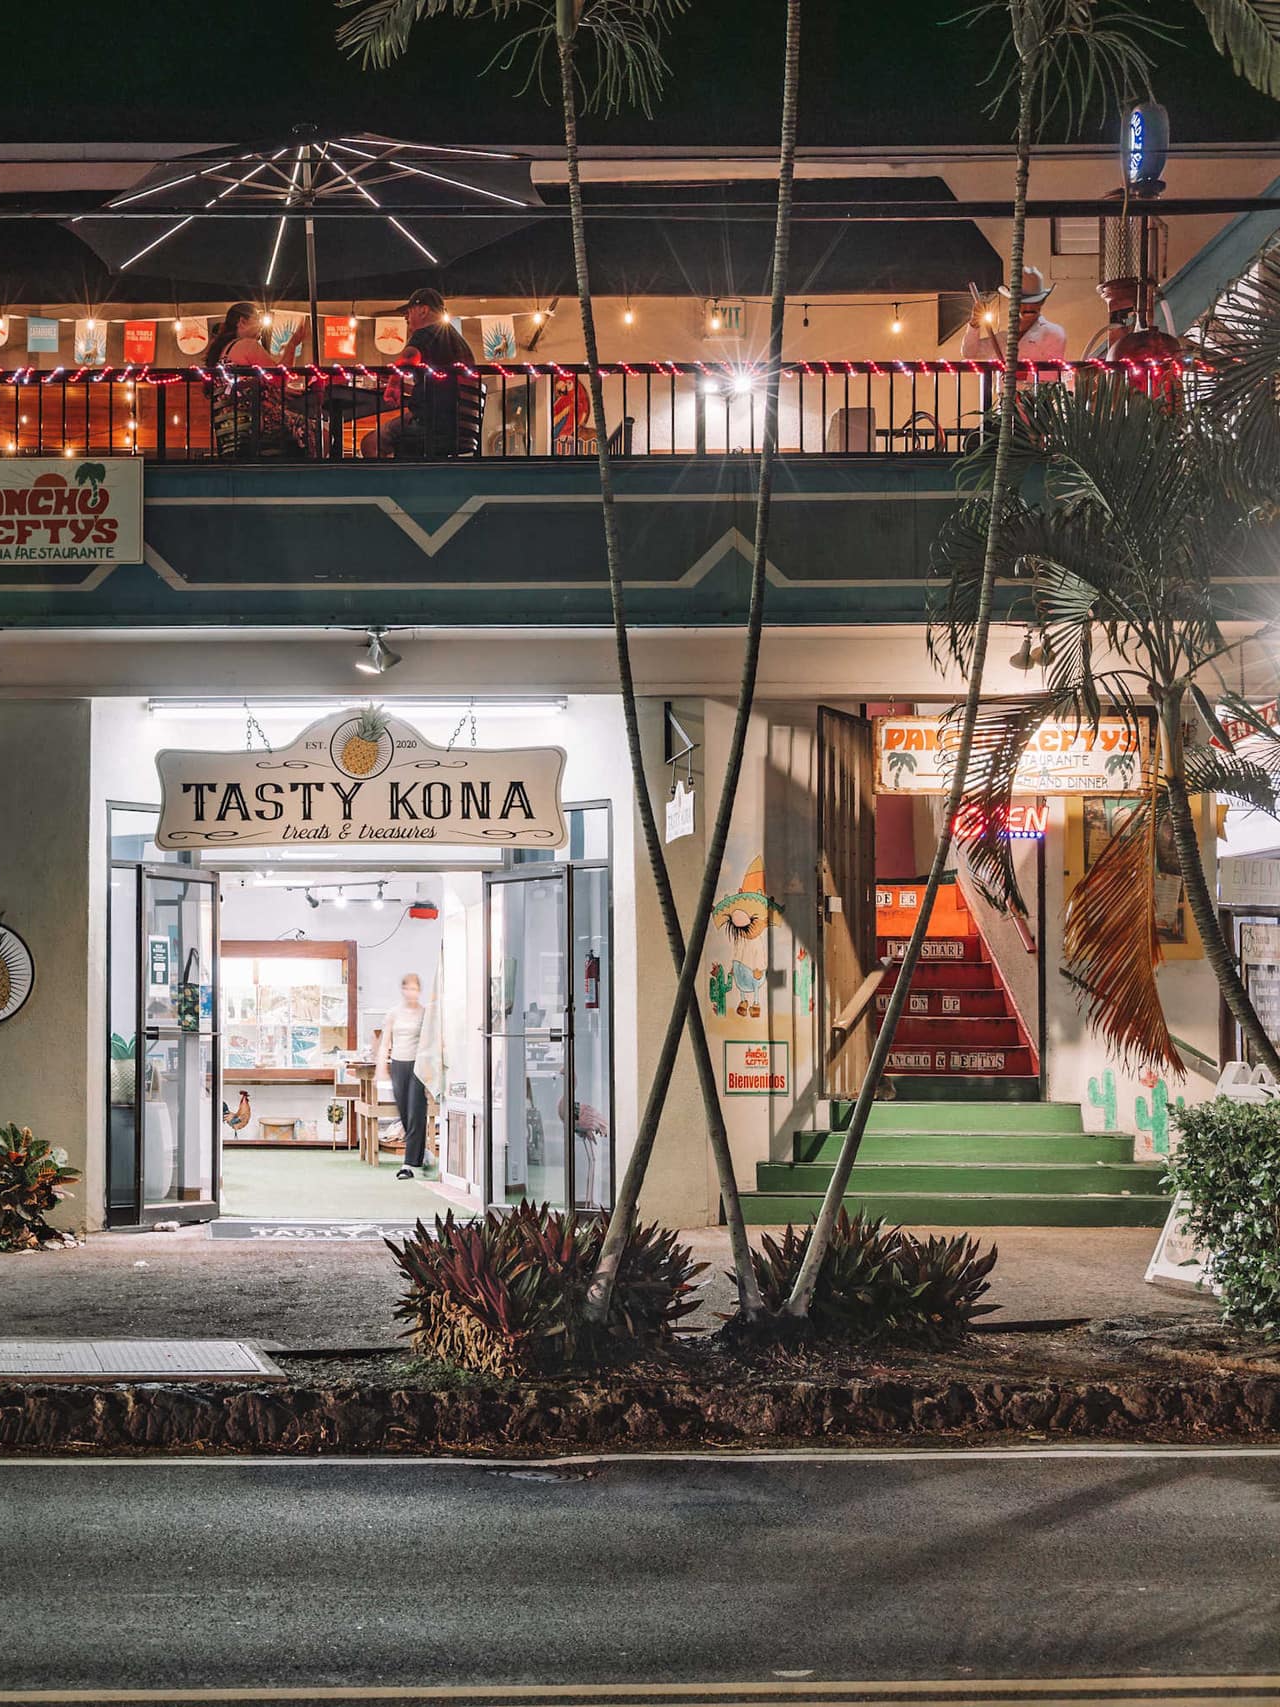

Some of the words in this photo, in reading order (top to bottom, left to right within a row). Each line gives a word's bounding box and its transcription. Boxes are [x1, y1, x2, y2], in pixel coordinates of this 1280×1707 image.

[21, 546, 115, 560] RESTAURANTE
[305, 741, 327, 751] EST.
[396, 740, 417, 749] 2020
[1039, 777, 1063, 788] AND
[1068, 777, 1108, 788] DINNER
[182, 781, 365, 822] TASTY
[389, 781, 536, 820] KONA
[951, 804, 1049, 838] OEN
[282, 823, 330, 840] treats
[338, 823, 351, 839] &
[358, 822, 438, 840] treasures
[922, 944, 963, 956] SHARE
[911, 998, 928, 1010] ON
[943, 1000, 960, 1010] UP
[886, 1055, 930, 1066] ANCHO
[937, 1055, 945, 1067] &
[951, 1055, 1004, 1068] LEFTYS
[729, 1073, 785, 1088] Bienvenidos
